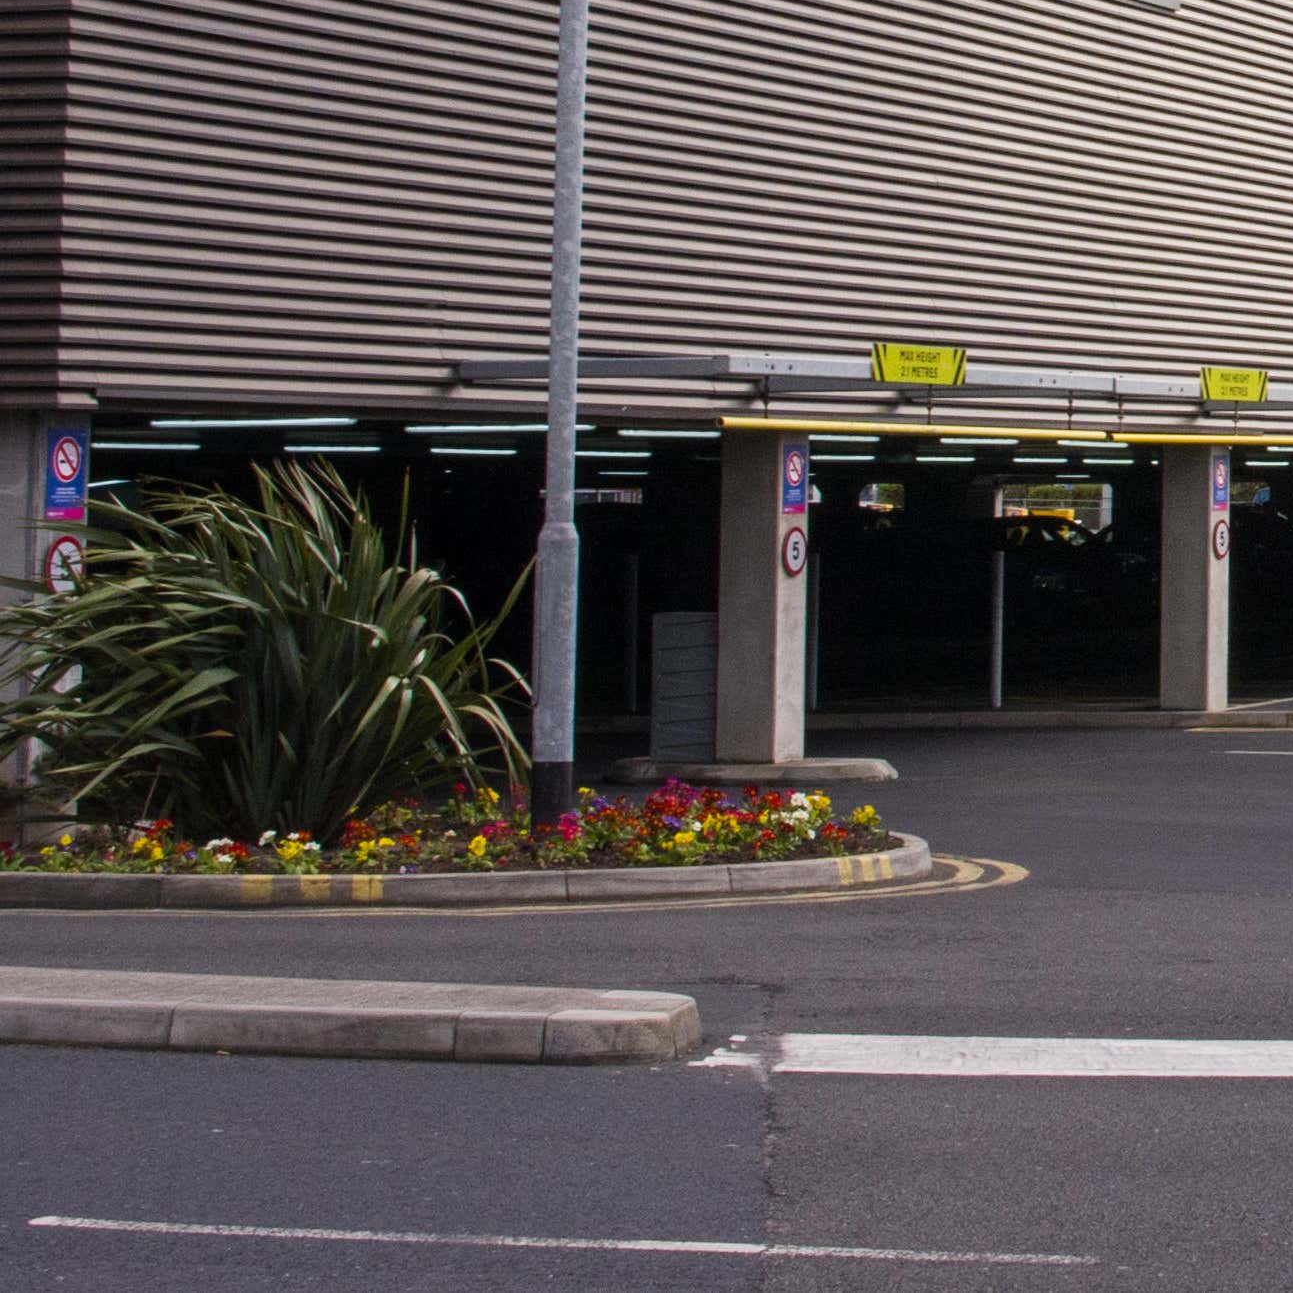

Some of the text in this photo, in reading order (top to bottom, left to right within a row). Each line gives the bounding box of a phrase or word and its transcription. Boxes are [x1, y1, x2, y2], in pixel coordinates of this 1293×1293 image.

[899, 350, 941, 364] MAX HEIGHT
[791, 541, 800, 561] 5
